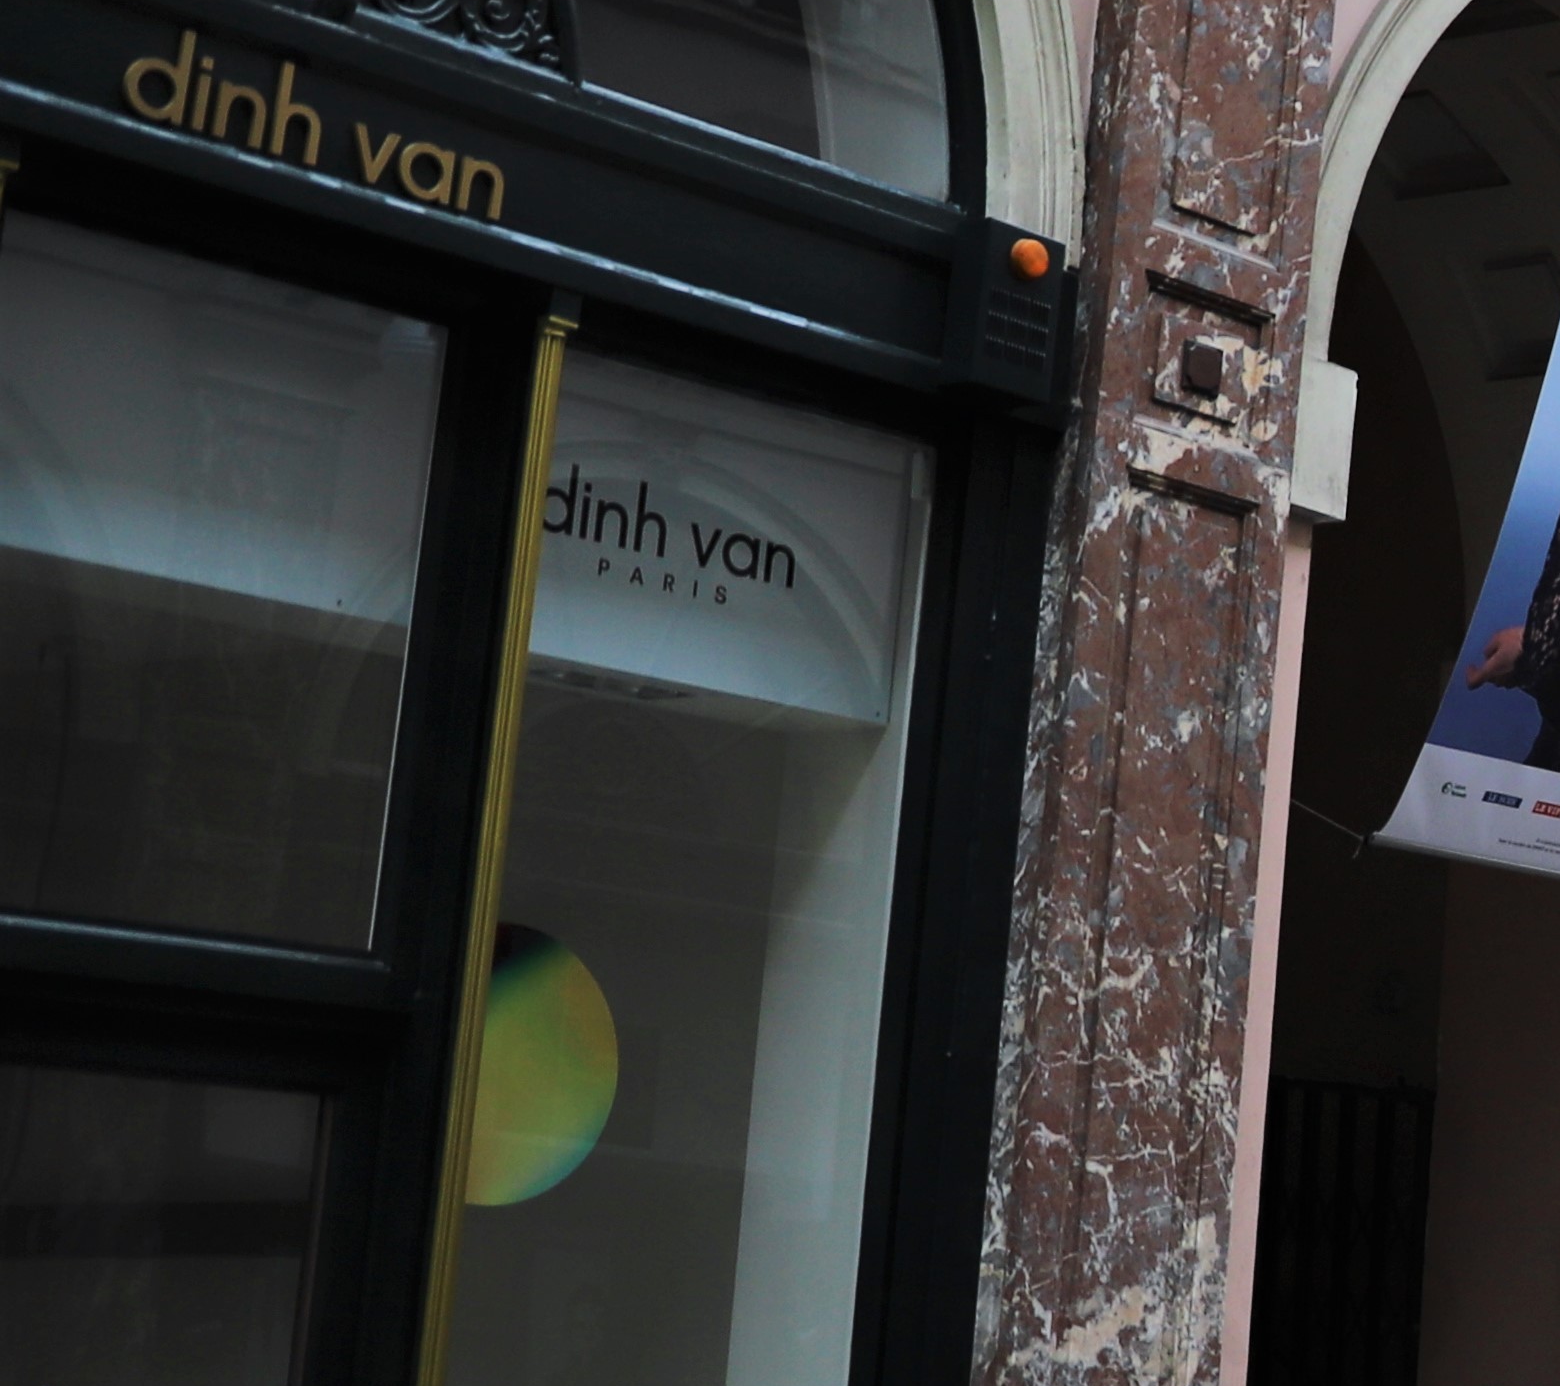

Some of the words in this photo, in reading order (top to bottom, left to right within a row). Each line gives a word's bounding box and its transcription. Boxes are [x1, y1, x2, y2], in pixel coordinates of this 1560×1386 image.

[125, 31, 321, 164] dinh
[356, 120, 504, 220] van
[543, 464, 667, 558] dinh
[692, 522, 795, 589] van
[598, 557, 727, 605] PARIS
